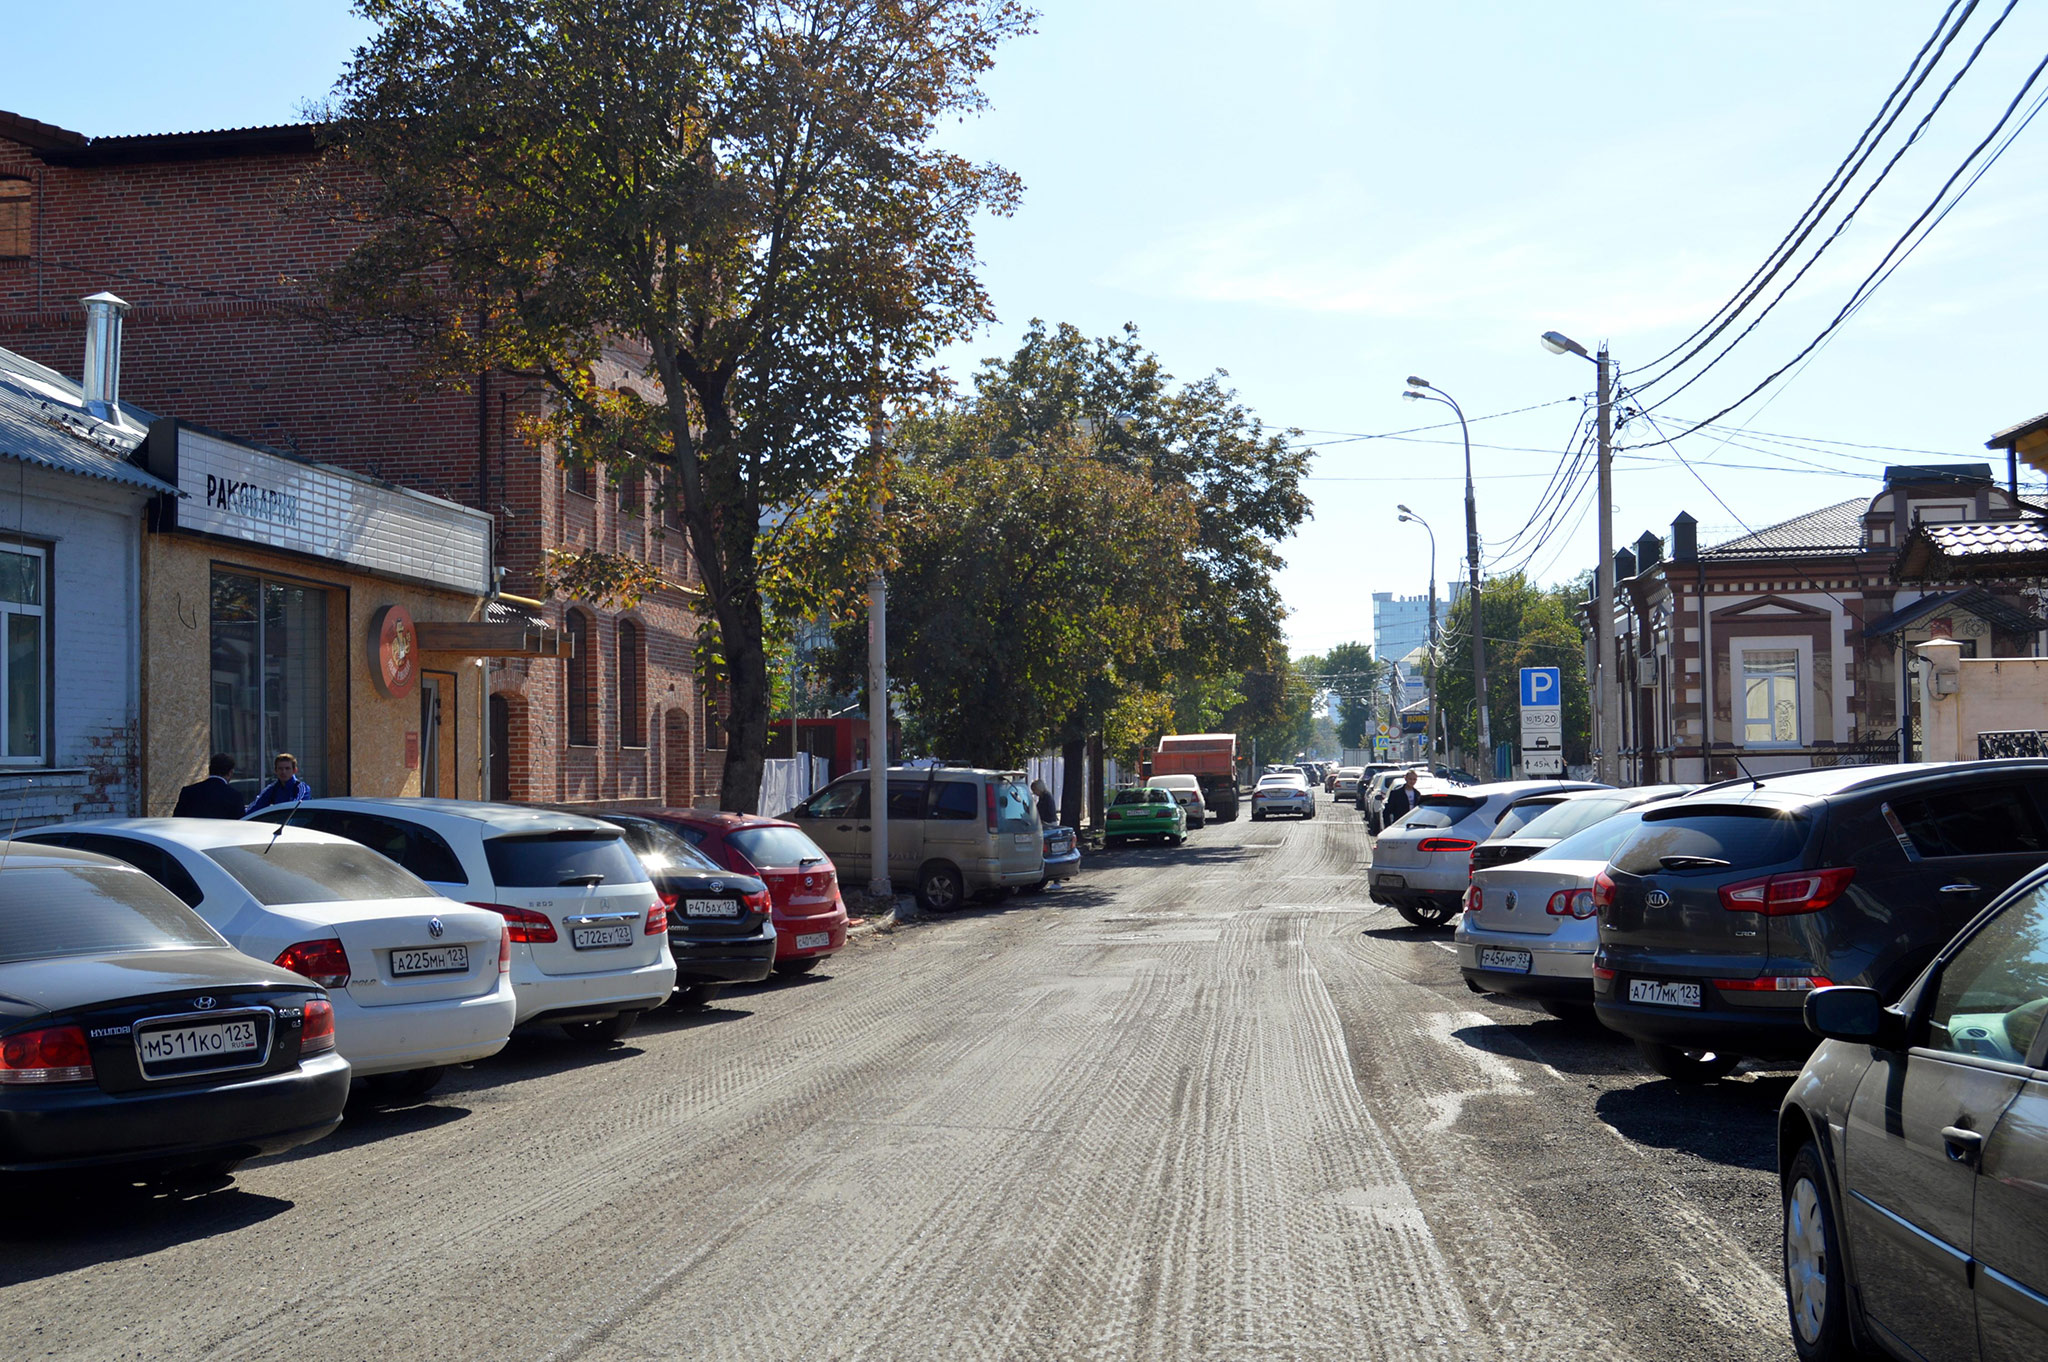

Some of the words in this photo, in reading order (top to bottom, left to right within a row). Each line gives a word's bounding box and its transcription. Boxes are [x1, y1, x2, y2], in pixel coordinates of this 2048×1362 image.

[207, 474, 297, 526] РАКОВАРНЯ
[1531, 672, 1552, 702] P
[1544, 714, 1556, 723] 20
[688, 901, 721, 913] Р476АХ
[723, 901, 735, 910] 123
[1648, 893, 1665, 905] KIA
[578, 930, 612, 945] С722ЕУ
[615, 927, 628, 938] 123
[398, 952, 445, 971] А225МН
[447, 948, 464, 961] 123
[1485, 951, 1515, 967] Р454МР
[1518, 953, 1527, 964] 93
[1633, 982, 1677, 1003] А717МК
[1680, 985, 1698, 999] 123
[91, 1026, 130, 1037] HYUNDAI
[149, 1031, 223, 1058] М511КО
[225, 1023, 251, 1042] 123
